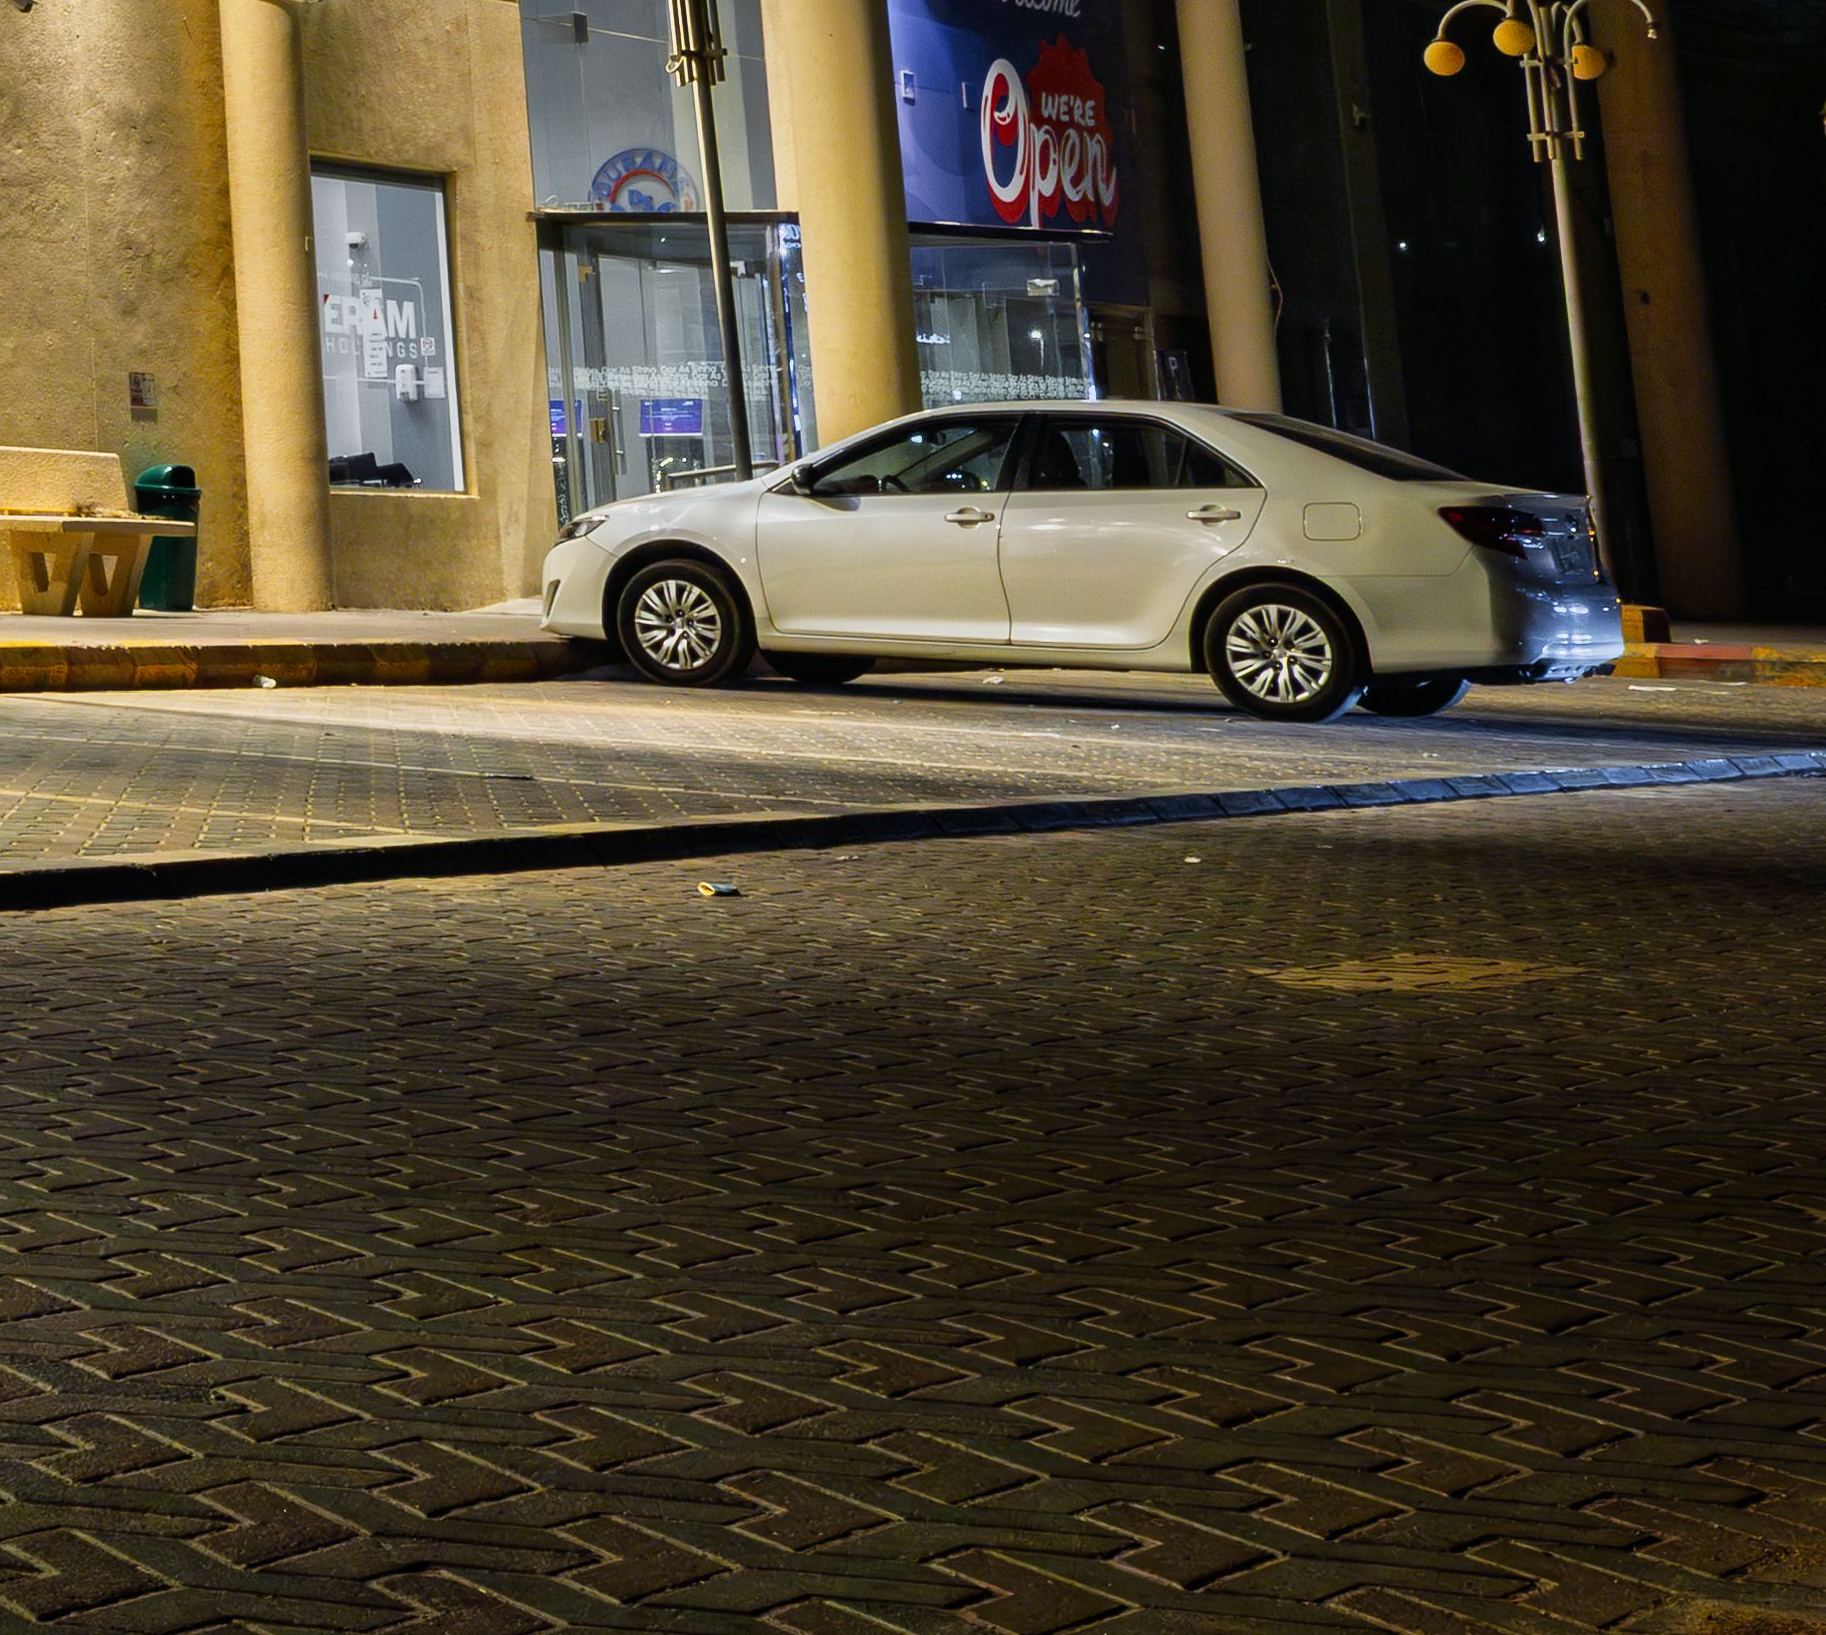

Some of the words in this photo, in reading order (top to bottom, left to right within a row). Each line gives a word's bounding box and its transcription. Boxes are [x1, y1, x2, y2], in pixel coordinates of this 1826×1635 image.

[1041, 92, 1095, 128] WE'RE
[980, 58, 1118, 228] Open
[326, 336, 418, 359] HOLNGS
